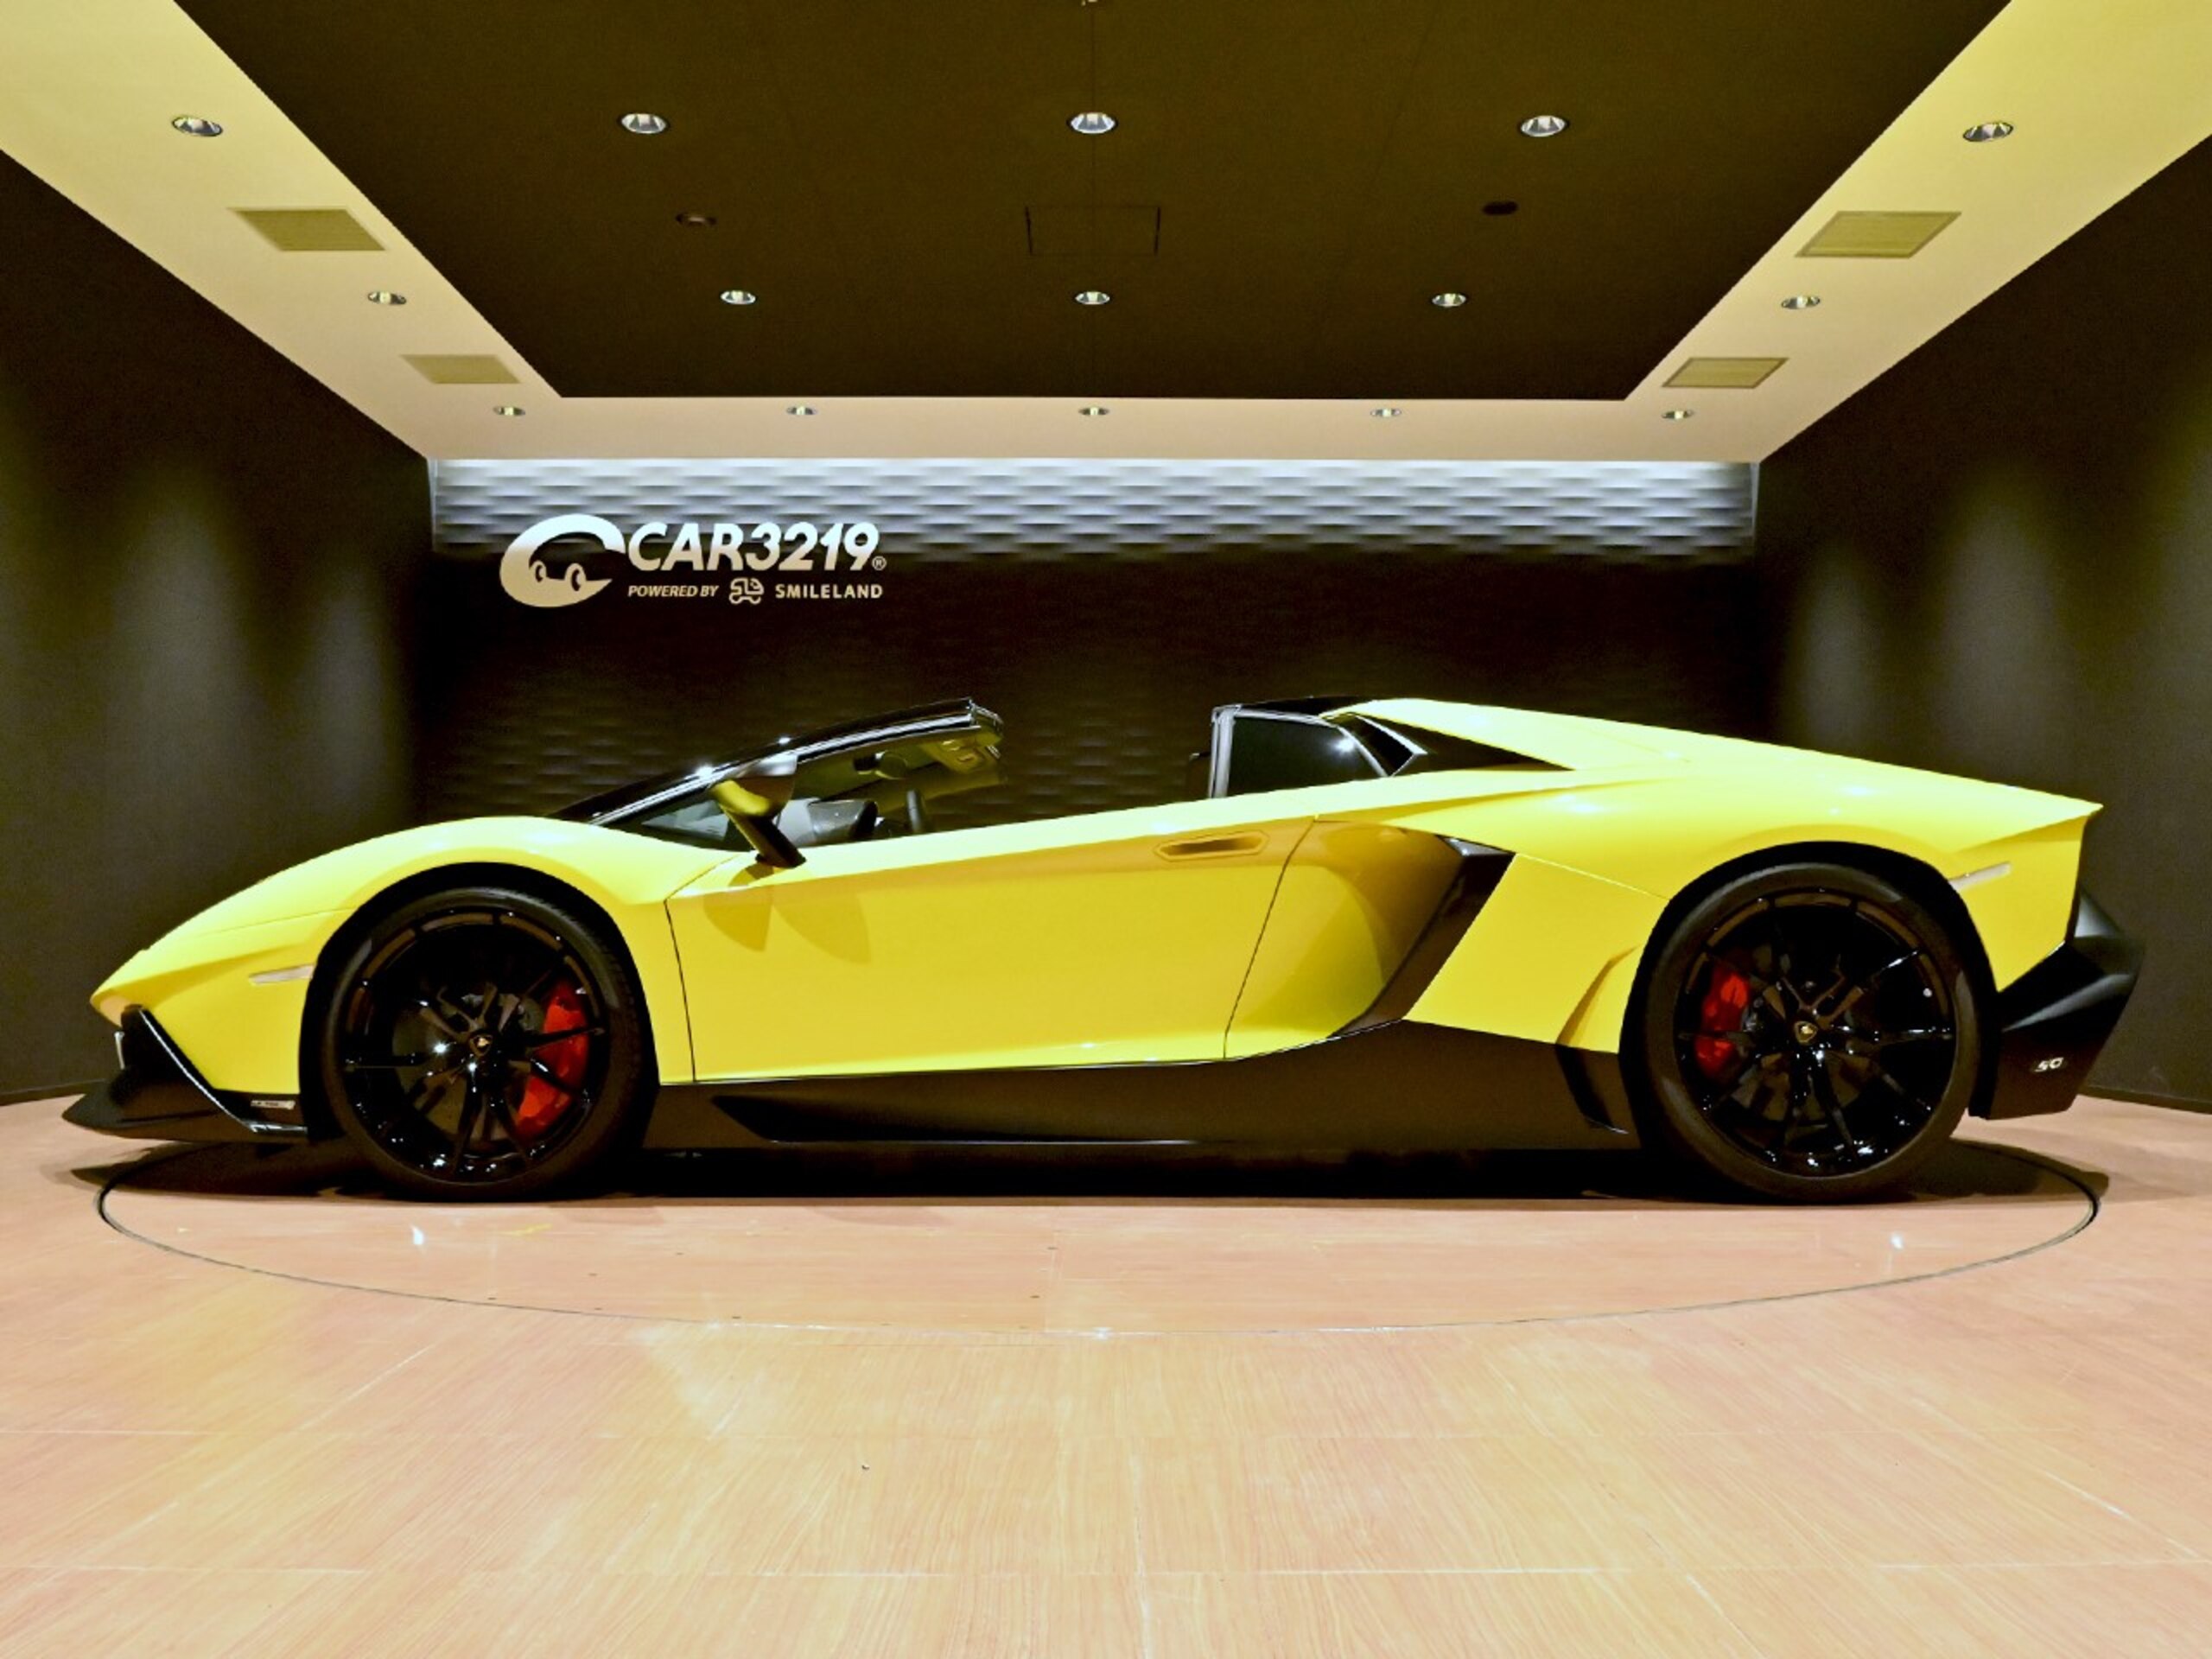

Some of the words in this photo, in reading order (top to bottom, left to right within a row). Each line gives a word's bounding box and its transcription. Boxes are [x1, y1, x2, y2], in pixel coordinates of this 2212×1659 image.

[627, 585, 698, 597] POWERED
[699, 585, 720, 597] BY
[775, 583, 883, 599] SMILELAND
